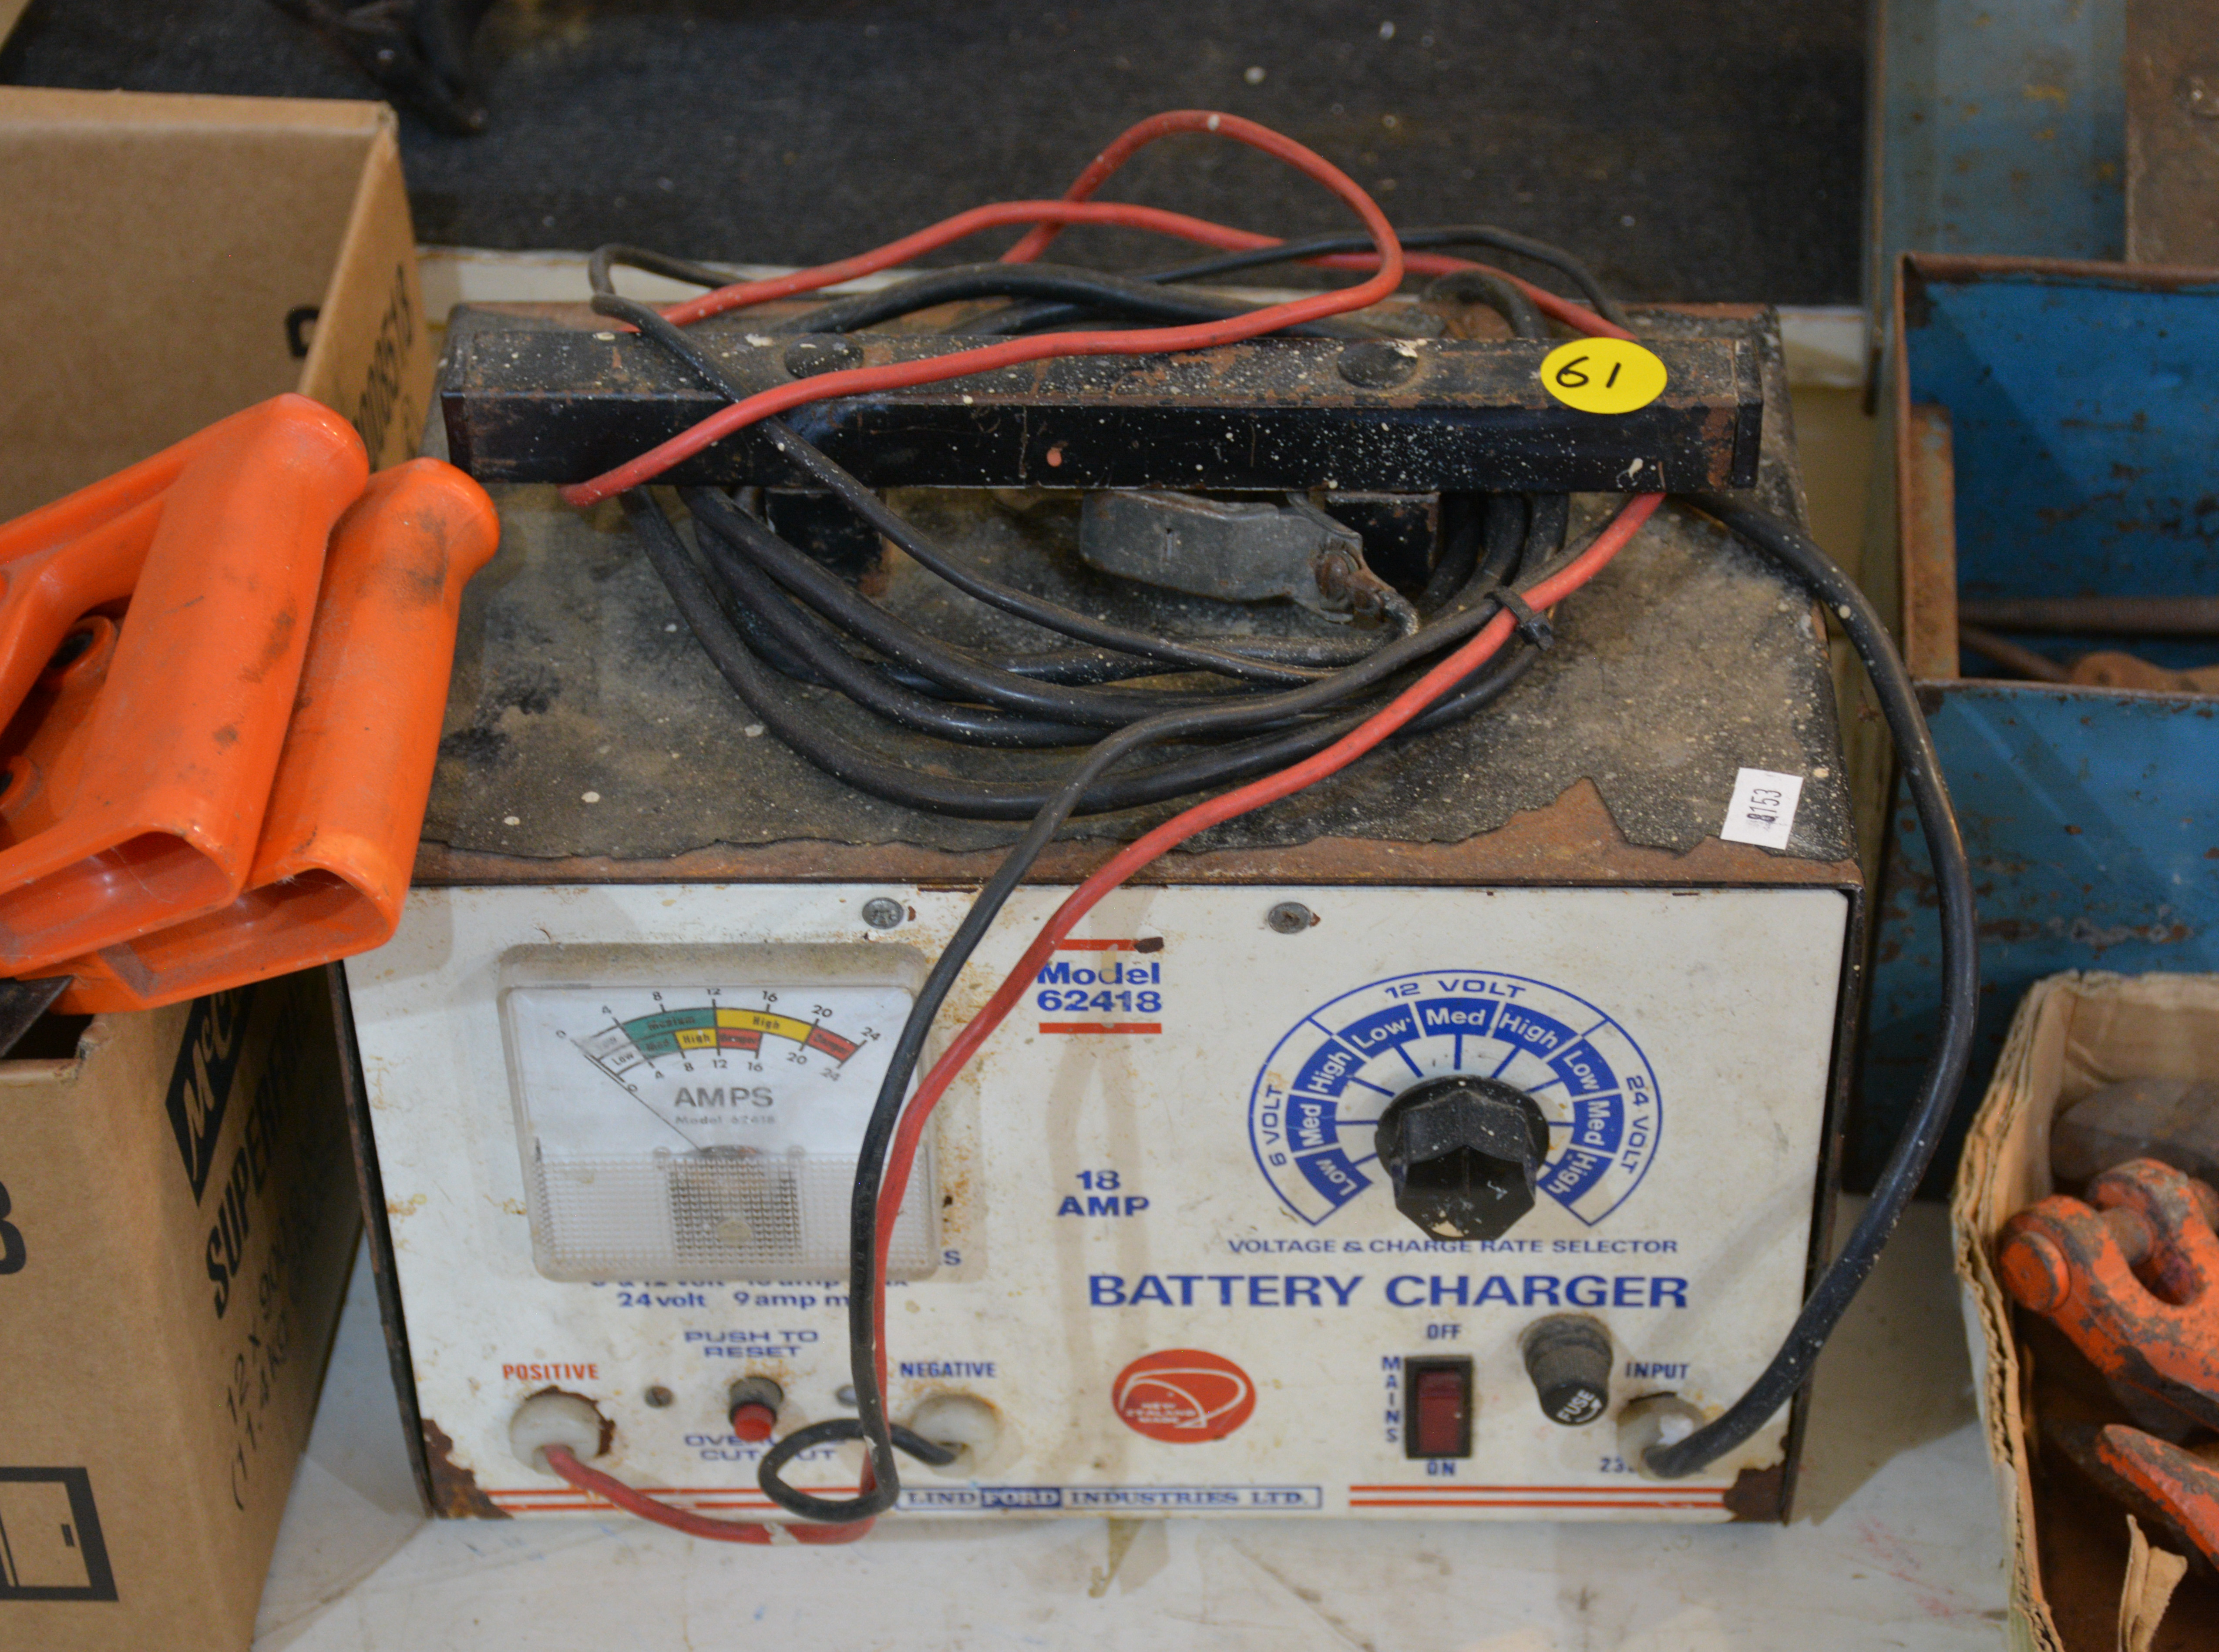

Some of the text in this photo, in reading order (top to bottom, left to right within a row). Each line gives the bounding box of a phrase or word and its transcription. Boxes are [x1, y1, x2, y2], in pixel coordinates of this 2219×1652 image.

[1556, 356, 1621, 389] 61
[1036, 962, 1161, 985] Model
[652, 991, 662, 1001] 8
[762, 990, 778, 1002] 16
[1385, 979, 1526, 1000] 12 VOLT
[602, 1005, 612, 1015] 4
[1036, 990, 1163, 1013] 62418
[812, 1004, 833, 1018] 20
[1426, 1007, 1487, 1027] Med
[752, 1016, 780, 1030] High
[1498, 1012, 1561, 1052] High
[683, 1034, 711, 1045] High
[861, 1027, 881, 1041] 24
[611, 1052, 635, 1066] Low
[684, 1062, 694, 1072] 8
[712, 1059, 728, 1069] 12
[747, 1061, 763, 1072] 16
[786, 1052, 808, 1065] 20
[655, 1070, 665, 1080] 4
[820, 1067, 841, 1081] 24
[1307, 1049, 1353, 1095] High
[1562, 1049, 1601, 1093] Low
[674, 1087, 774, 1108] AMPS
[675, 1115, 722, 1125] Model
[1261, 1083, 1283, 1146] VOLT
[1298, 1103, 1323, 1149] Med
[1586, 1100, 1606, 1148] Med
[1622, 1074, 1650, 1175] 24 VOLT
[1075, 1169, 1121, 1192] 18
[1314, 1157, 1359, 1197] Low
[1547, 1152, 1598, 1196] High
[1056, 1195, 1150, 1218] AMP
[1227, 1239, 1678, 1254] VOLTAGE & CHARGE RATE SELECTOR
[617, 1292, 652, 1307] 24
[656, 1292, 707, 1307] volt
[733, 1291, 750, 1305] 9
[755, 1295, 817, 1310] amp
[1088, 1275, 1688, 1308] BATTERY CHARGER
[684, 1331, 819, 1343] PUSH TO
[1426, 1323, 1462, 1340] OFF
[703, 1345, 804, 1358] RESET
[502, 1363, 600, 1381] POSITIVE
[899, 1361, 997, 1379] NEGATIVE
[1625, 1362, 1690, 1380] INPUT
[1382, 1357, 1401, 1443] MAINS
[1556, 1389, 1595, 1422] FUSE
[1426, 1462, 1456, 1476] ON
[1071, 1491, 1238, 1505] INDUSTRIES
